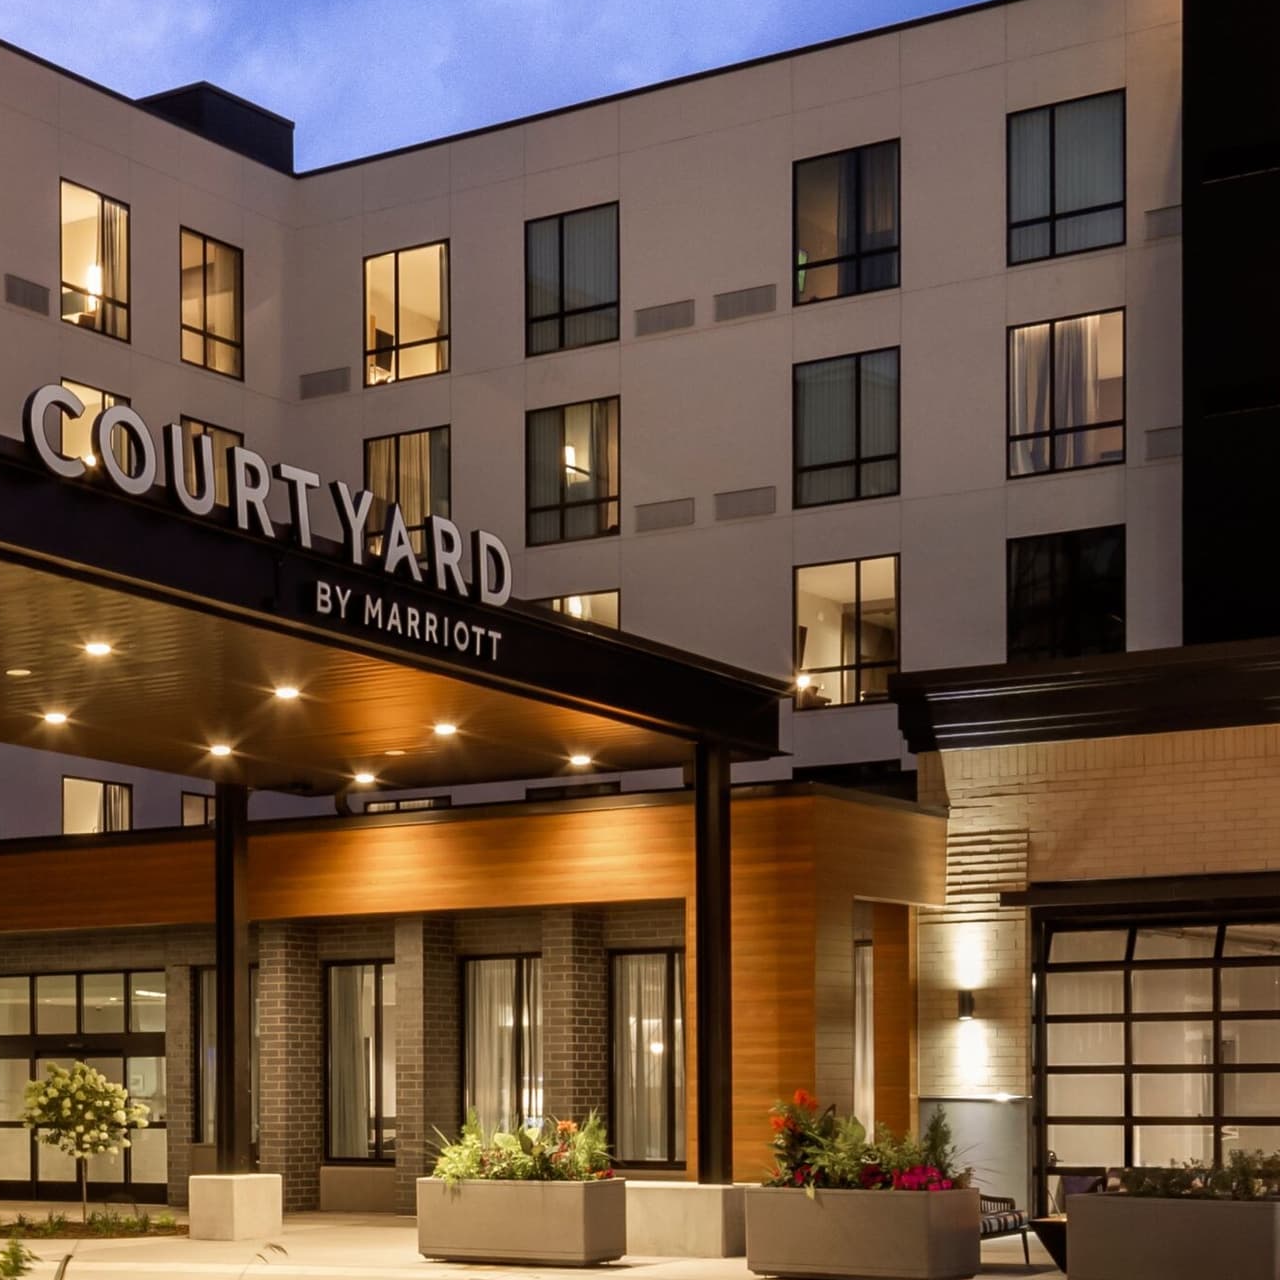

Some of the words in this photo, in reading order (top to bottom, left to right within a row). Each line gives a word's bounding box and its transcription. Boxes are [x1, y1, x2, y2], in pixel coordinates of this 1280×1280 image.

[23, 384, 513, 607] COURTYARD
[316, 580, 352, 619] BY
[364, 594, 502, 661] MARRIOTT
